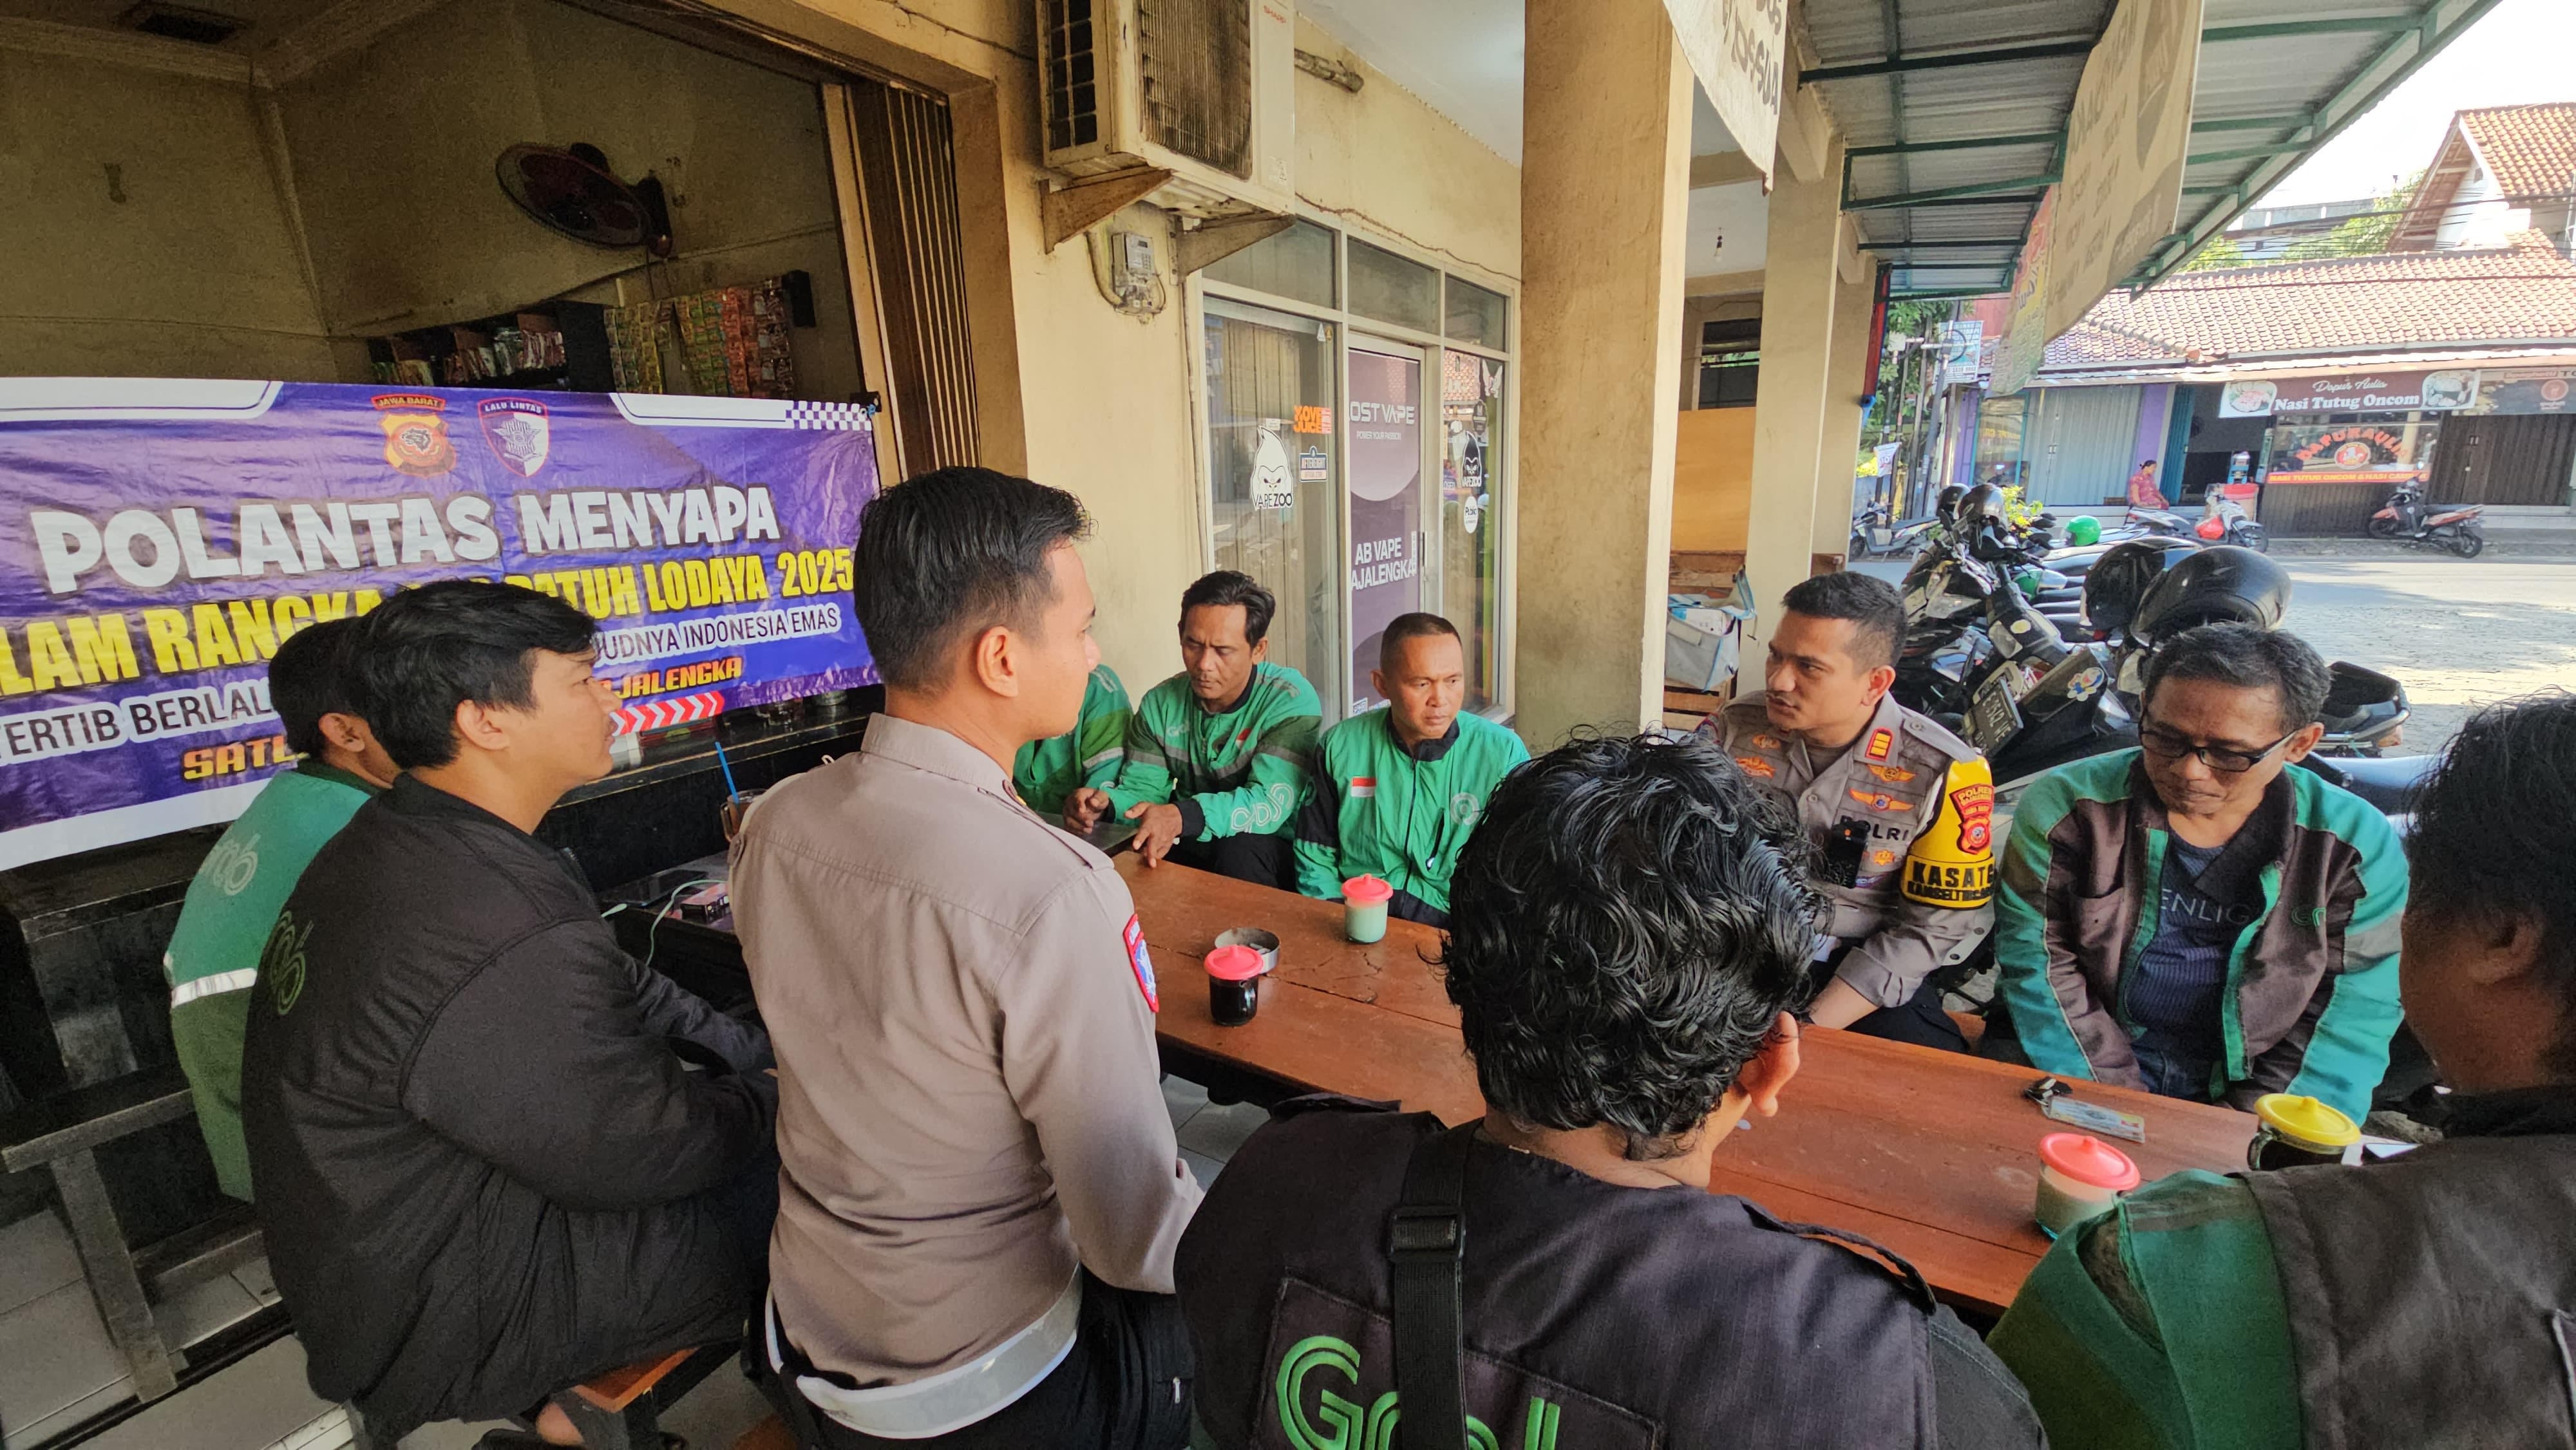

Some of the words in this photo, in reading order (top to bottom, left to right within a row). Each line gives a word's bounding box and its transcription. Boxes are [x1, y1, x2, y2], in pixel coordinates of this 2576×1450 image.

[378, 397, 406, 407] JAWA
[406, 397, 439, 407] BARAT
[484, 402, 507, 412] LALU
[509, 401, 543, 413] LINTAS
[1349, 401, 1381, 422] OST
[1381, 404, 1416, 425] VAPE
[2274, 396, 2309, 411] Nasi
[2311, 396, 2362, 410] Tutug
[2362, 393, 2420, 407] Oncom
[2269, 473, 2291, 482] NASI
[30, 496, 500, 594] POLANTAS
[518, 487, 781, 554] MENYAPA
[1355, 542, 1372, 565] AB
[1373, 537, 1402, 561] VAPE
[642, 555, 770, 612] LODAYA
[777, 548, 854, 598] 2025
[0, 708, 121, 759] ERTIB
[683, 614, 788, 649] INDONESIA
[791, 607, 838, 633] EMAS
[183, 735, 310, 780] SATL
